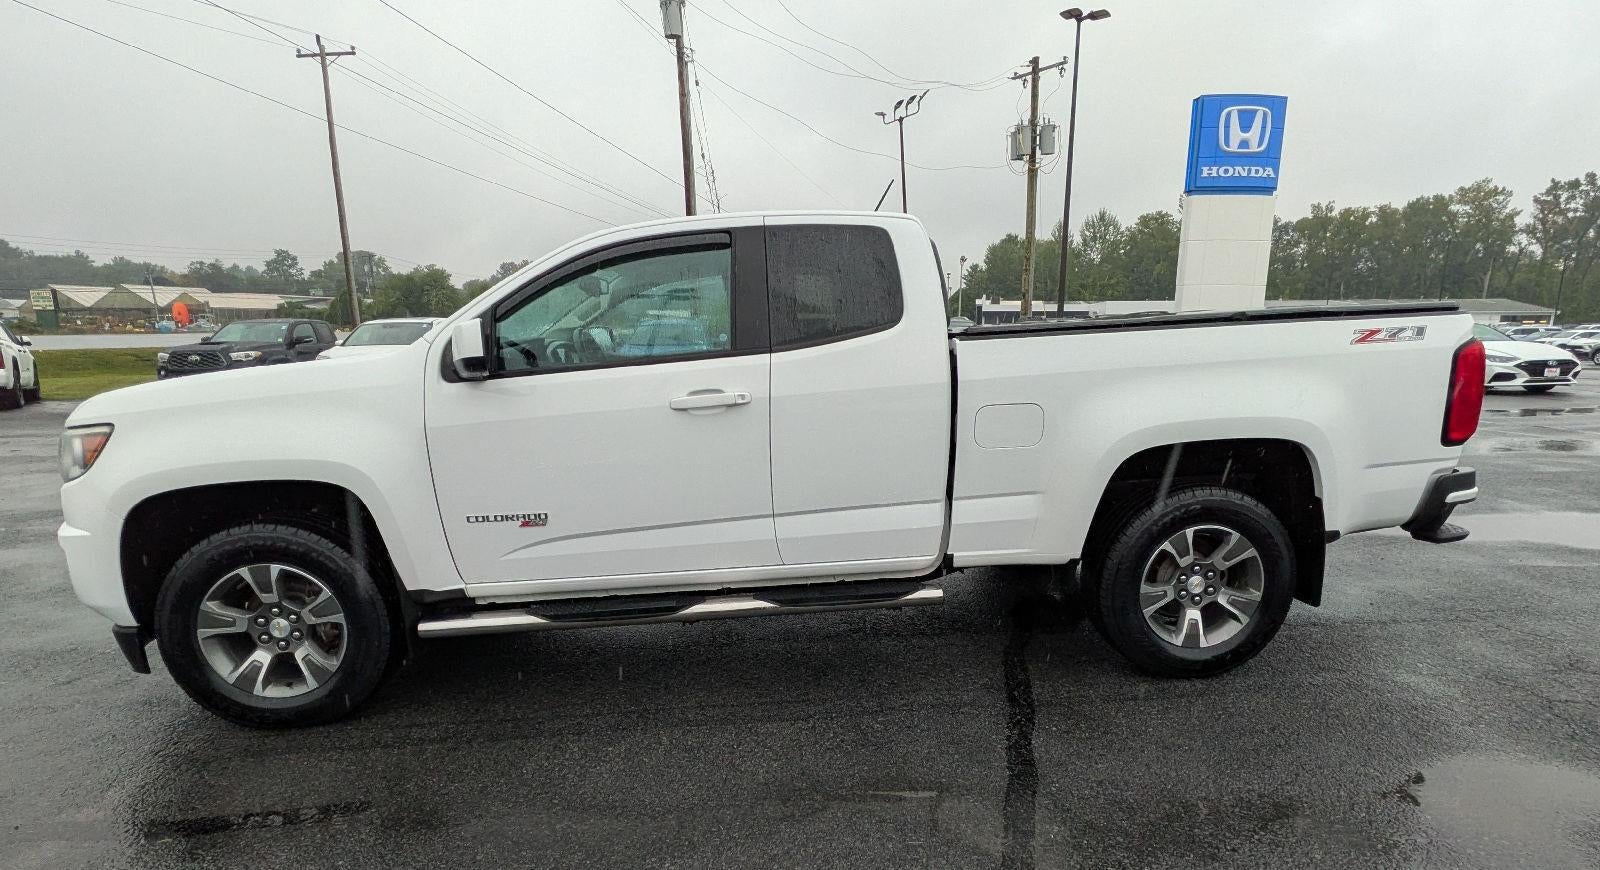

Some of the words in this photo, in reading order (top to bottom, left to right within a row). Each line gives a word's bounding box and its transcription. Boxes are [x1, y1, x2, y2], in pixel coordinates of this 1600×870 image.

[1201, 166, 1276, 178] HONDA
[1350, 325, 1427, 345] Z71
[466, 512, 548, 523] COLORADO
